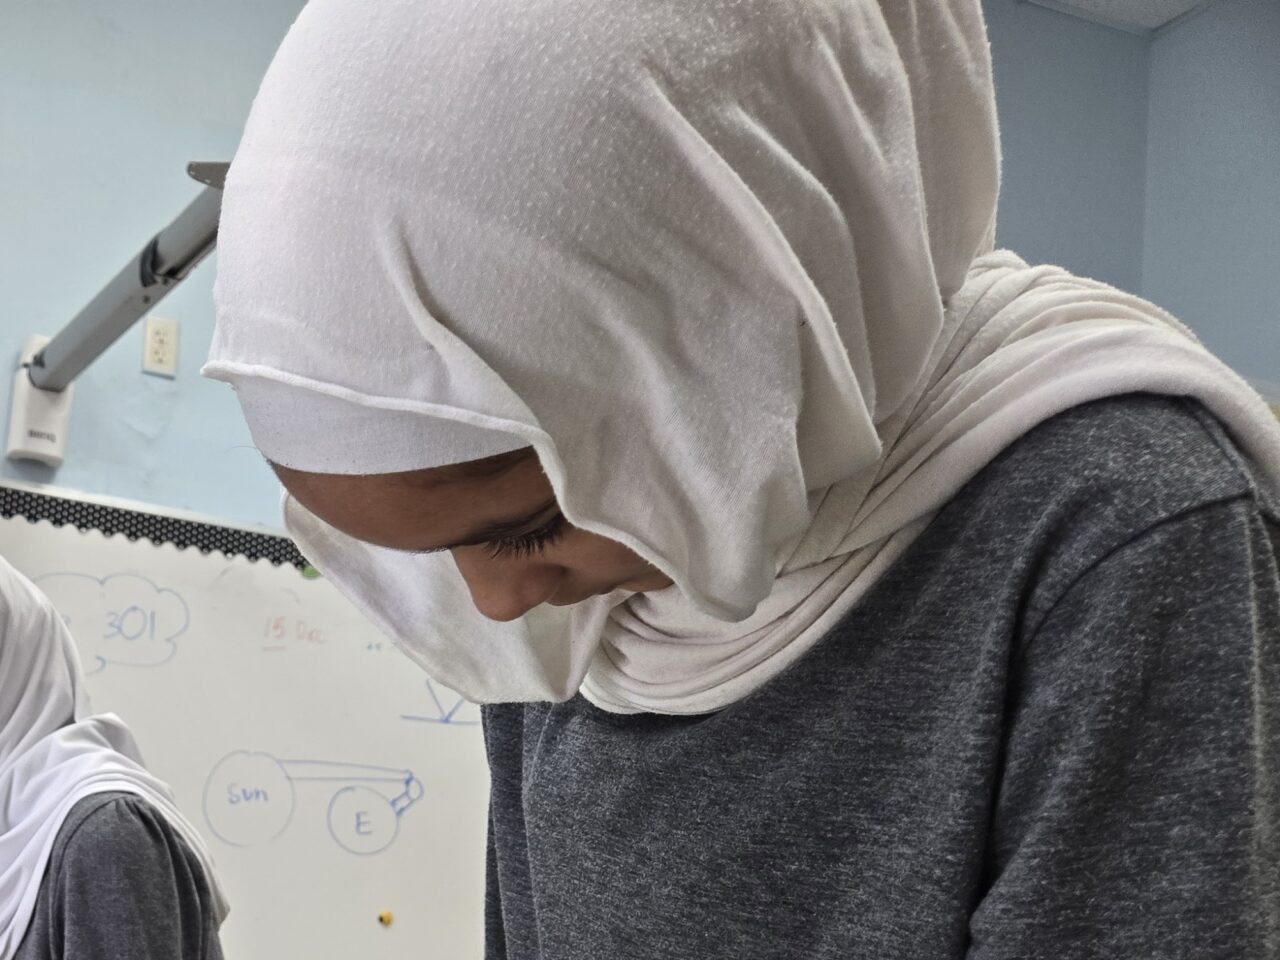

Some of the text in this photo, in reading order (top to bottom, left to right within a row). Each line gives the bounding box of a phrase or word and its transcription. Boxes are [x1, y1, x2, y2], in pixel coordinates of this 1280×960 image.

[103, 605, 156, 641] 301
[227, 783, 269, 804] Sun
[355, 811, 373, 835] E
